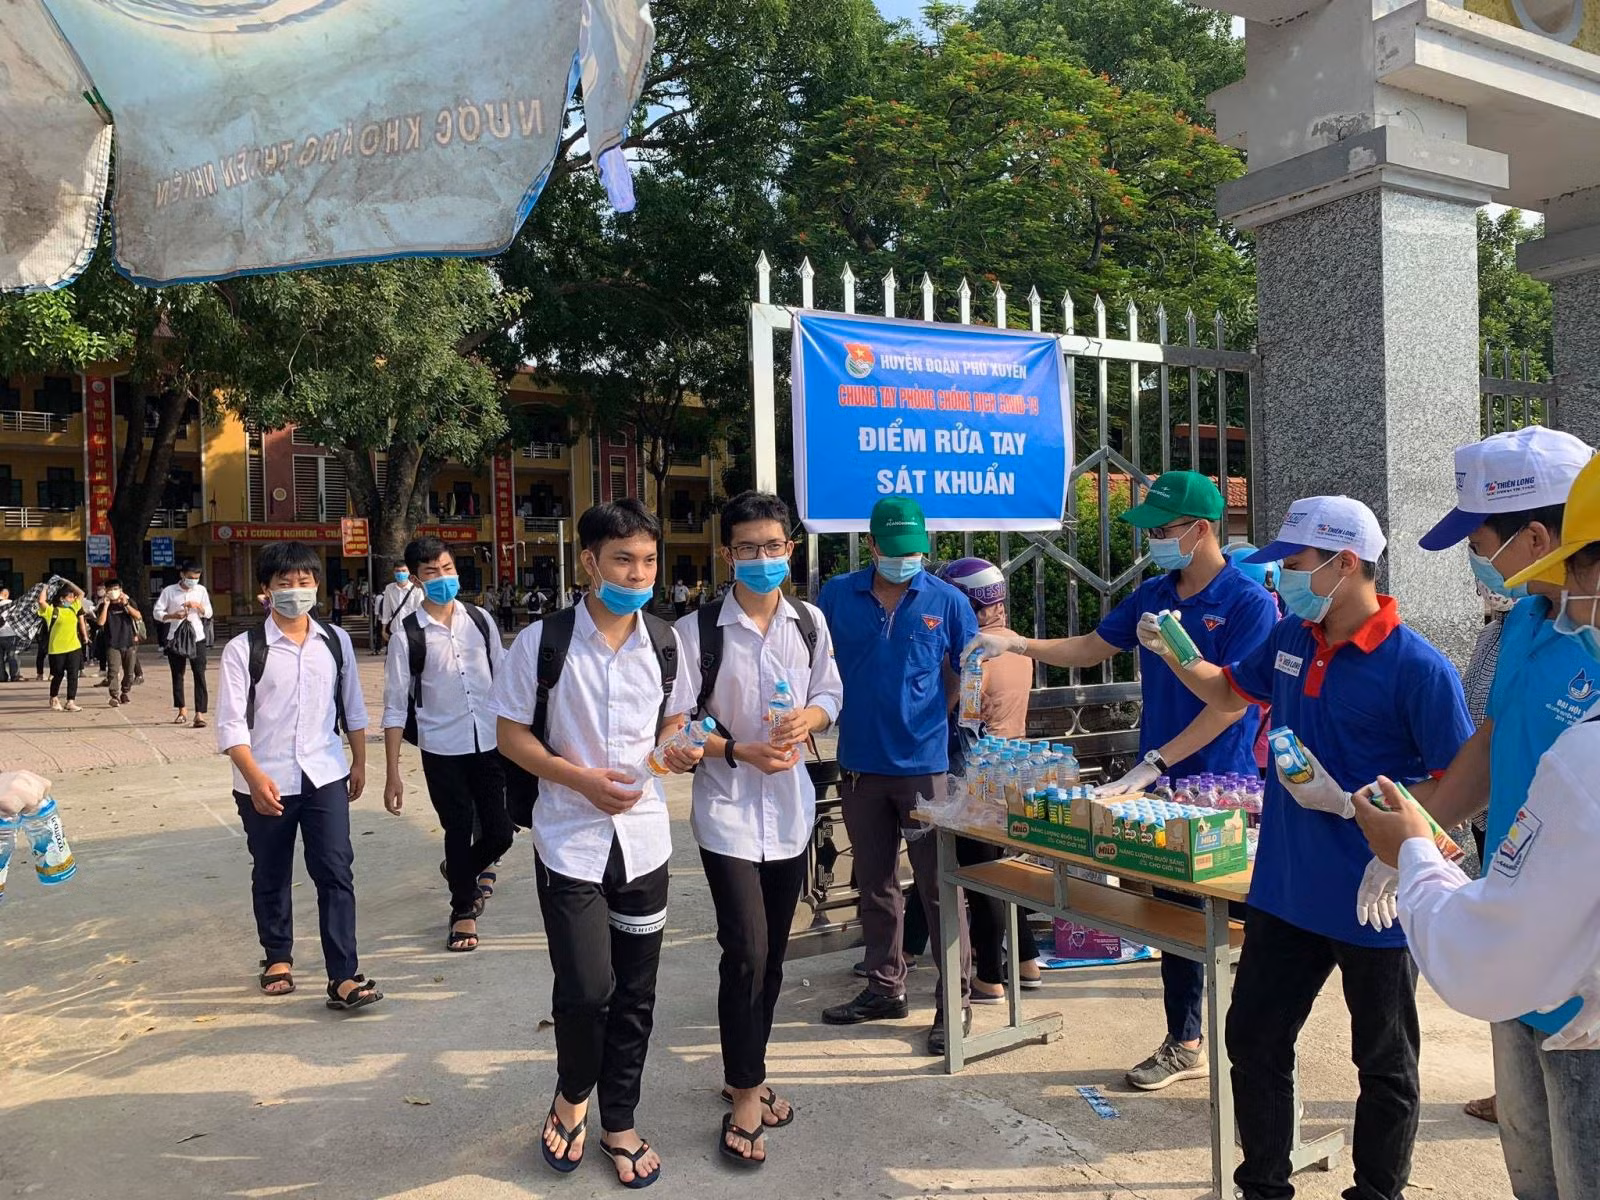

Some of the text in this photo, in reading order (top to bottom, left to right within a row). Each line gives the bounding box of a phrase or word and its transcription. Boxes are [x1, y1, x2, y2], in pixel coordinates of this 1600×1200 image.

[880, 354, 922, 373] HUYỆN
[838, 384, 877, 407] CHUNG
[880, 386, 898, 408] TAY
[900, 383, 935, 410] PHÒNG
[938, 384, 971, 412] CHỐNG
[858, 418, 1027, 455] ĐIỂM RỬA TAY
[876, 462, 1015, 495] SÁT KHUẨN
[1516, 476, 1535, 486] LONG
